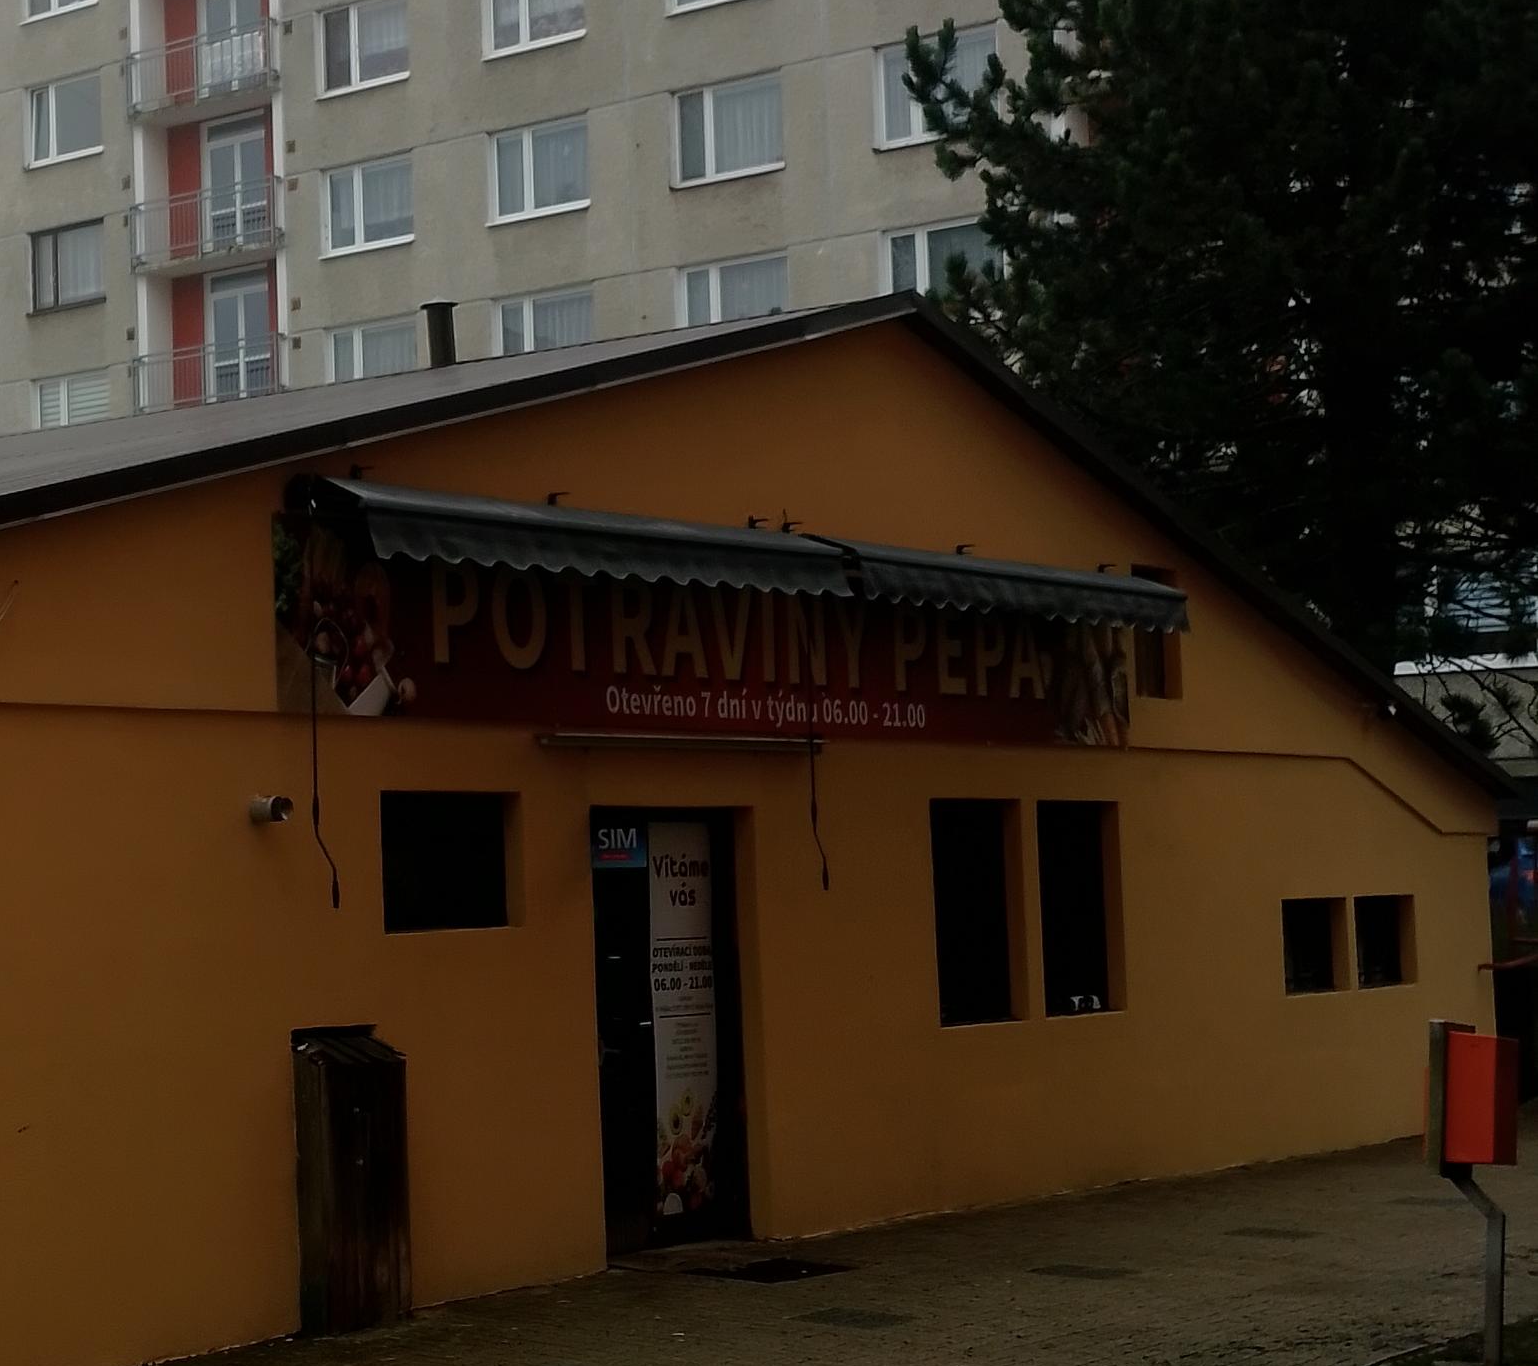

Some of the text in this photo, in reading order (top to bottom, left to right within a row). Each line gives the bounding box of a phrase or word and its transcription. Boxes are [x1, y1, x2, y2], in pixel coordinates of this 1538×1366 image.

[430, 557, 1045, 699] POTRAVINY PEPA
[606, 685, 696, 717] Otevřeno
[701, 691, 711, 718] 7
[718, 689, 747, 719] dní
[752, 700, 762, 720] v
[823, 698, 868, 725] 06.00
[883, 702, 927, 729] 21.00
[598, 828, 638, 850] SIM
[653, 853, 709, 878] Vítáme
[670, 881, 696, 906] vás
[653, 977, 682, 991] 06.00
